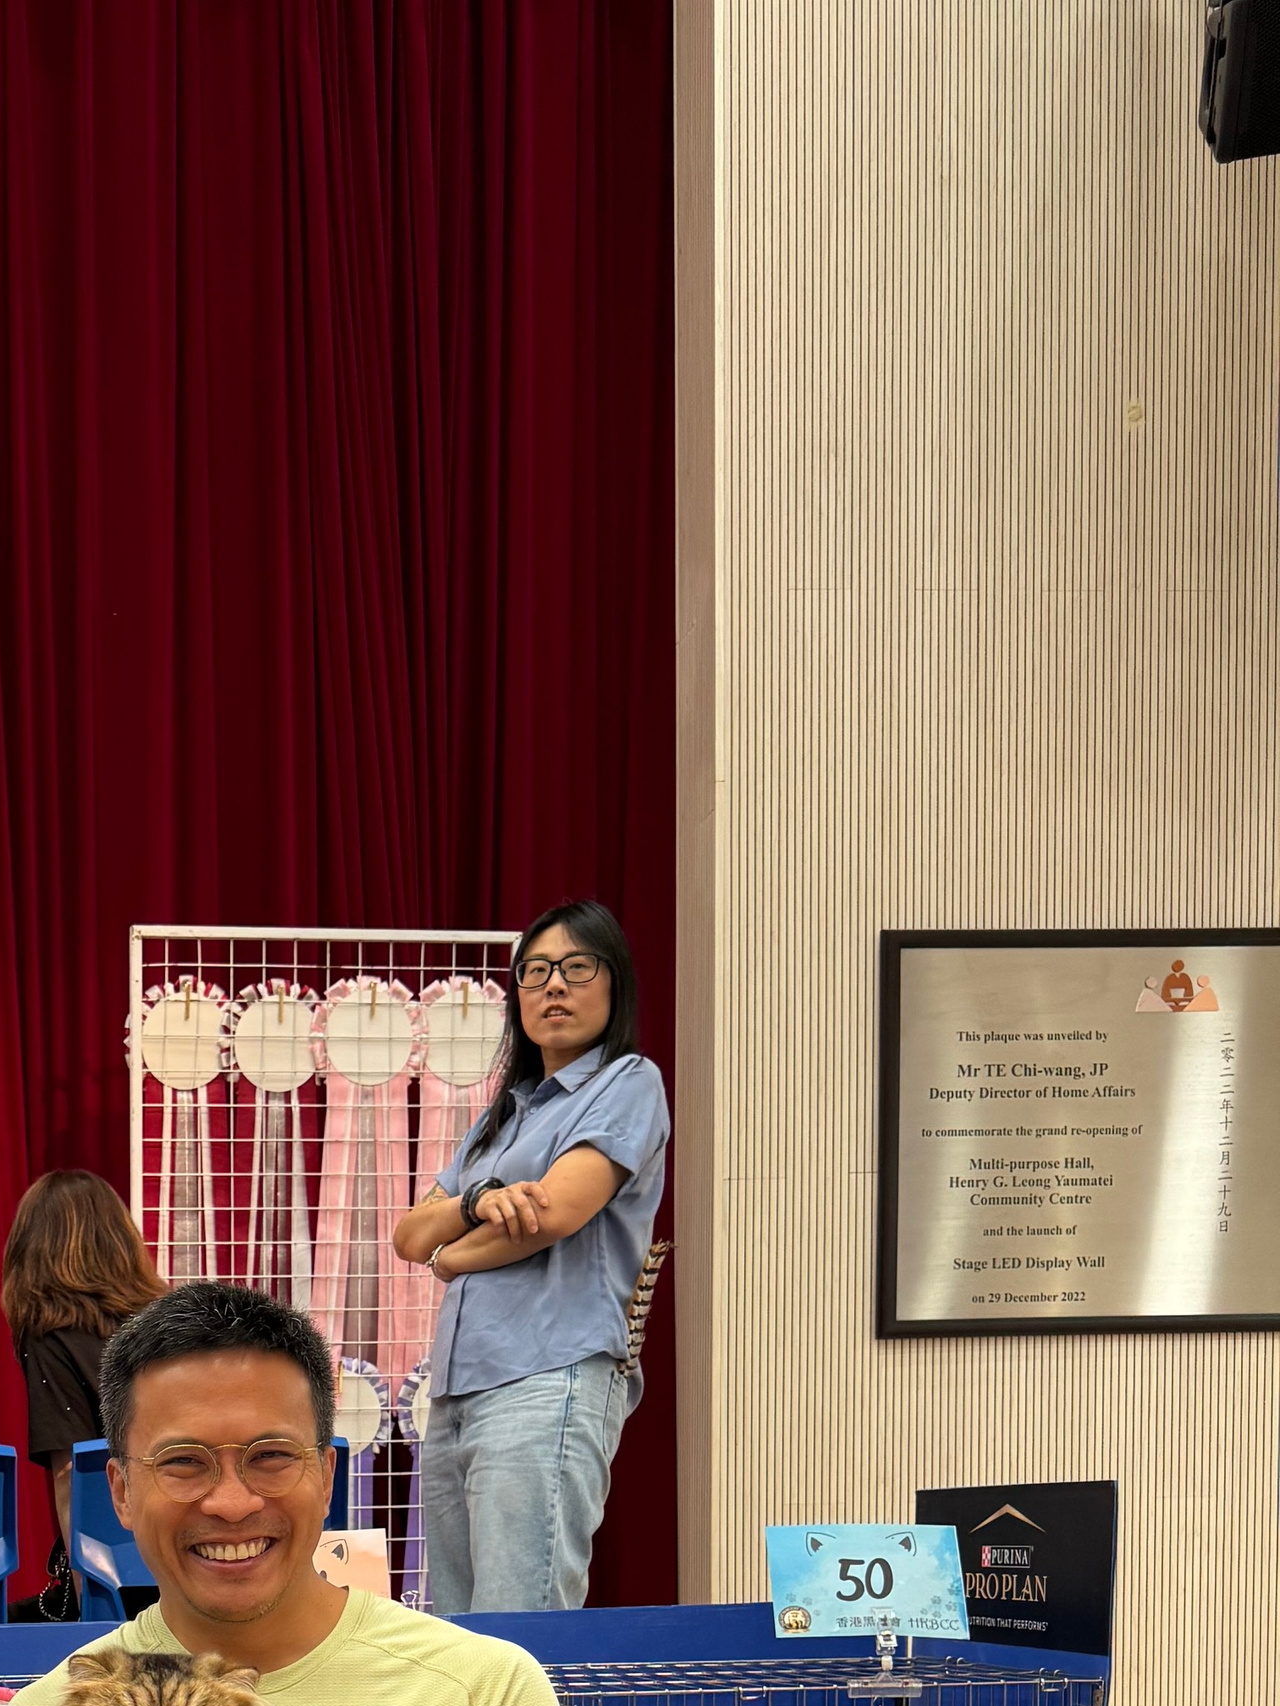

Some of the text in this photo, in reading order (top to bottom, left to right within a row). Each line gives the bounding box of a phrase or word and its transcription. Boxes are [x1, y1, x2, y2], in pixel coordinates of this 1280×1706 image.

[957, 1030, 1108, 1045] This plaque was unveiled by
[957, 1063, 1108, 1079] Mr TE Chi-wang, JP
[929, 1085, 1135, 1101] Deputy Director of Home Affairs
[922, 1124, 1143, 1138] to commemorate the grand re-opening of
[1217, 1032, 1235, 1233] 二零二二年十二月二十九日
[969, 1157, 1094, 1172] Multi-purpose Hall,
[949, 1175, 1113, 1190] Henry G. Leong Yaumatei
[970, 1193, 1092, 1207] Community Centre
[983, 1225, 1077, 1236] and the launch of
[953, 1256, 1104, 1271] Stage LED Display Wall
[972, 1291, 1085, 1303] on 29 December 2022
[992, 1549, 1028, 1564] PURINA
[836, 1557, 894, 1601] 50
[965, 1573, 1047, 1602] PRO PLAN
[997, 1618, 1012, 1628] THAT
[1013, 1620, 1046, 1631] PERFORMS
